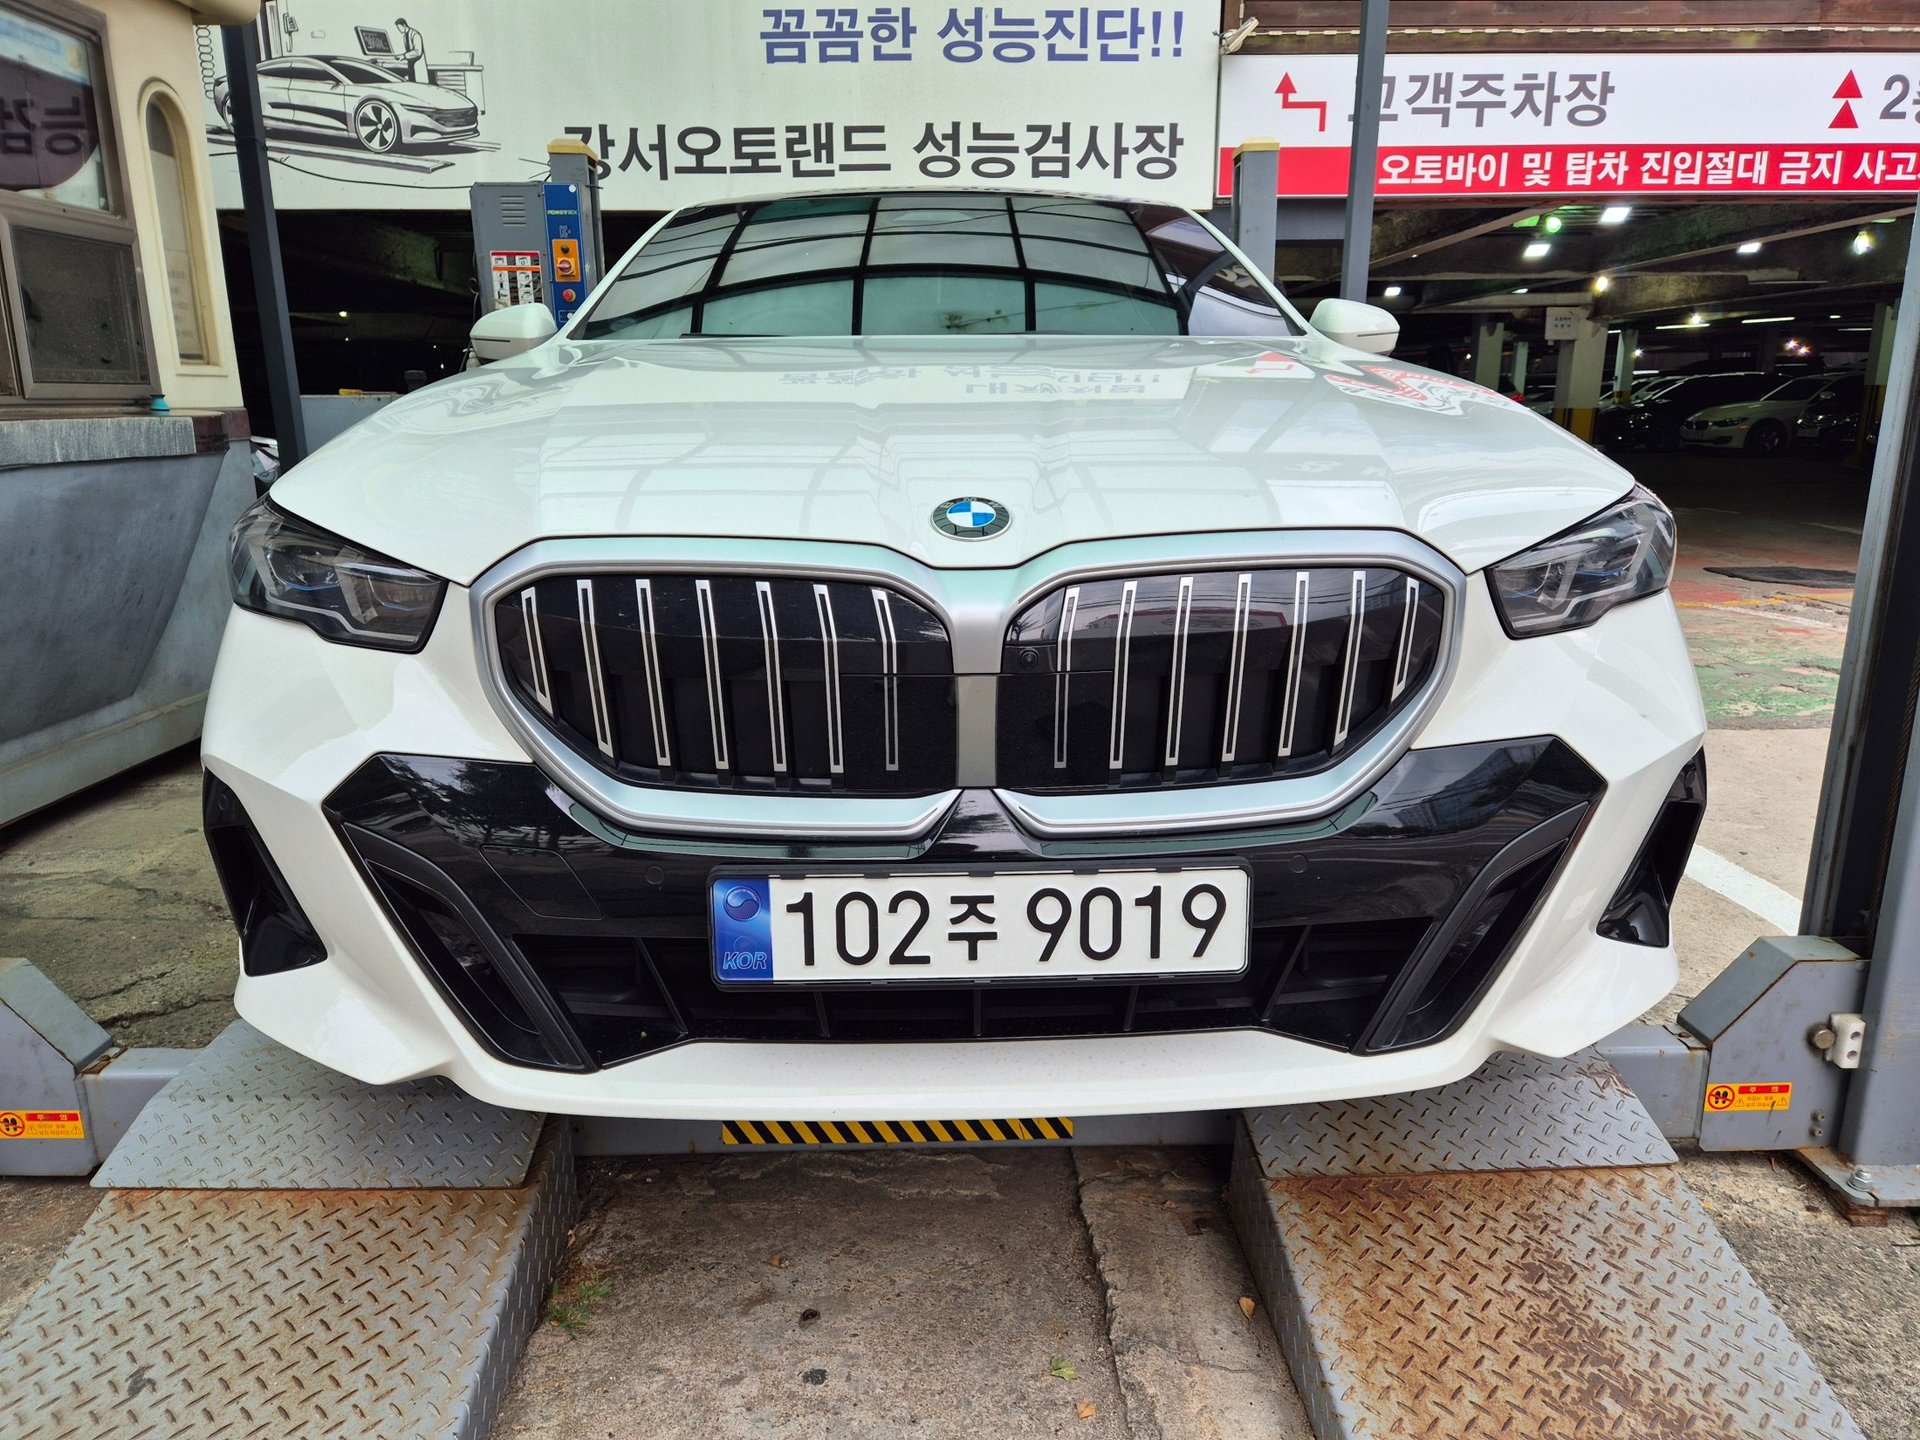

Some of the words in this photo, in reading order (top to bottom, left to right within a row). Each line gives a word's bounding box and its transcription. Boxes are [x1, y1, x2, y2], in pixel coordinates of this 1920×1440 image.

[760, 7, 917, 64] 꼼꼼한
[937, 6, 1185, 63] 성능진단!!
[1879, 73, 1920, 124] 2
[564, 122, 891, 181] 강서오토랜드
[913, 121, 1184, 180] 성능검사장
[1378, 152, 1509, 187] 오토바이
[1522, 151, 1552, 187] 및
[1565, 151, 1629, 186] 탑차
[1640, 151, 1769, 185] 진입절대
[1779, 151, 1843, 185] 금지
[1852, 150, 1920, 185] 사고
[786, 889, 998, 966] 102주
[1026, 883, 1228, 963] 9019
[722, 951, 768, 970] KOR
